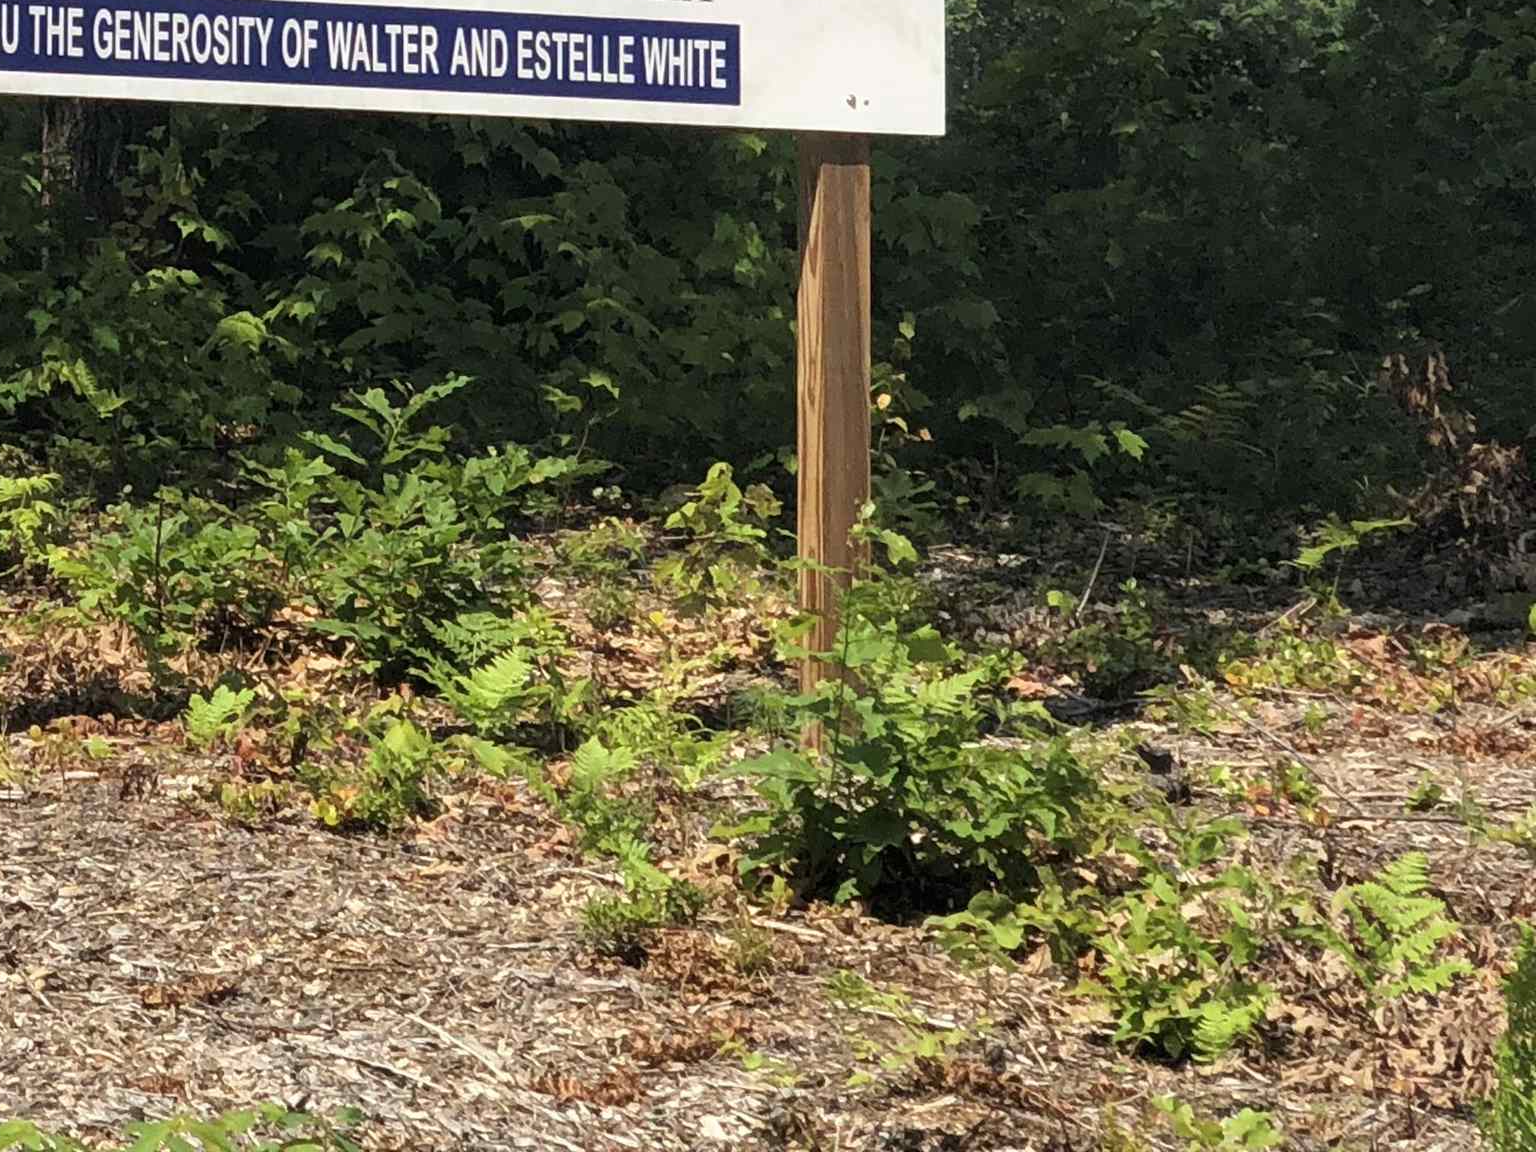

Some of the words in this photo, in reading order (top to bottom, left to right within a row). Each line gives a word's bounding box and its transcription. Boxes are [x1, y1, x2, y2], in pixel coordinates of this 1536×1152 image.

[29, 6, 83, 56] THE
[94, 9, 273, 65] GENEROSITY
[282, 19, 318, 67] OF
[327, 21, 439, 74] WALTER
[451, 28, 508, 76] AND
[518, 31, 634, 83] ESTELLE
[643, 37, 726, 88] WHITE
